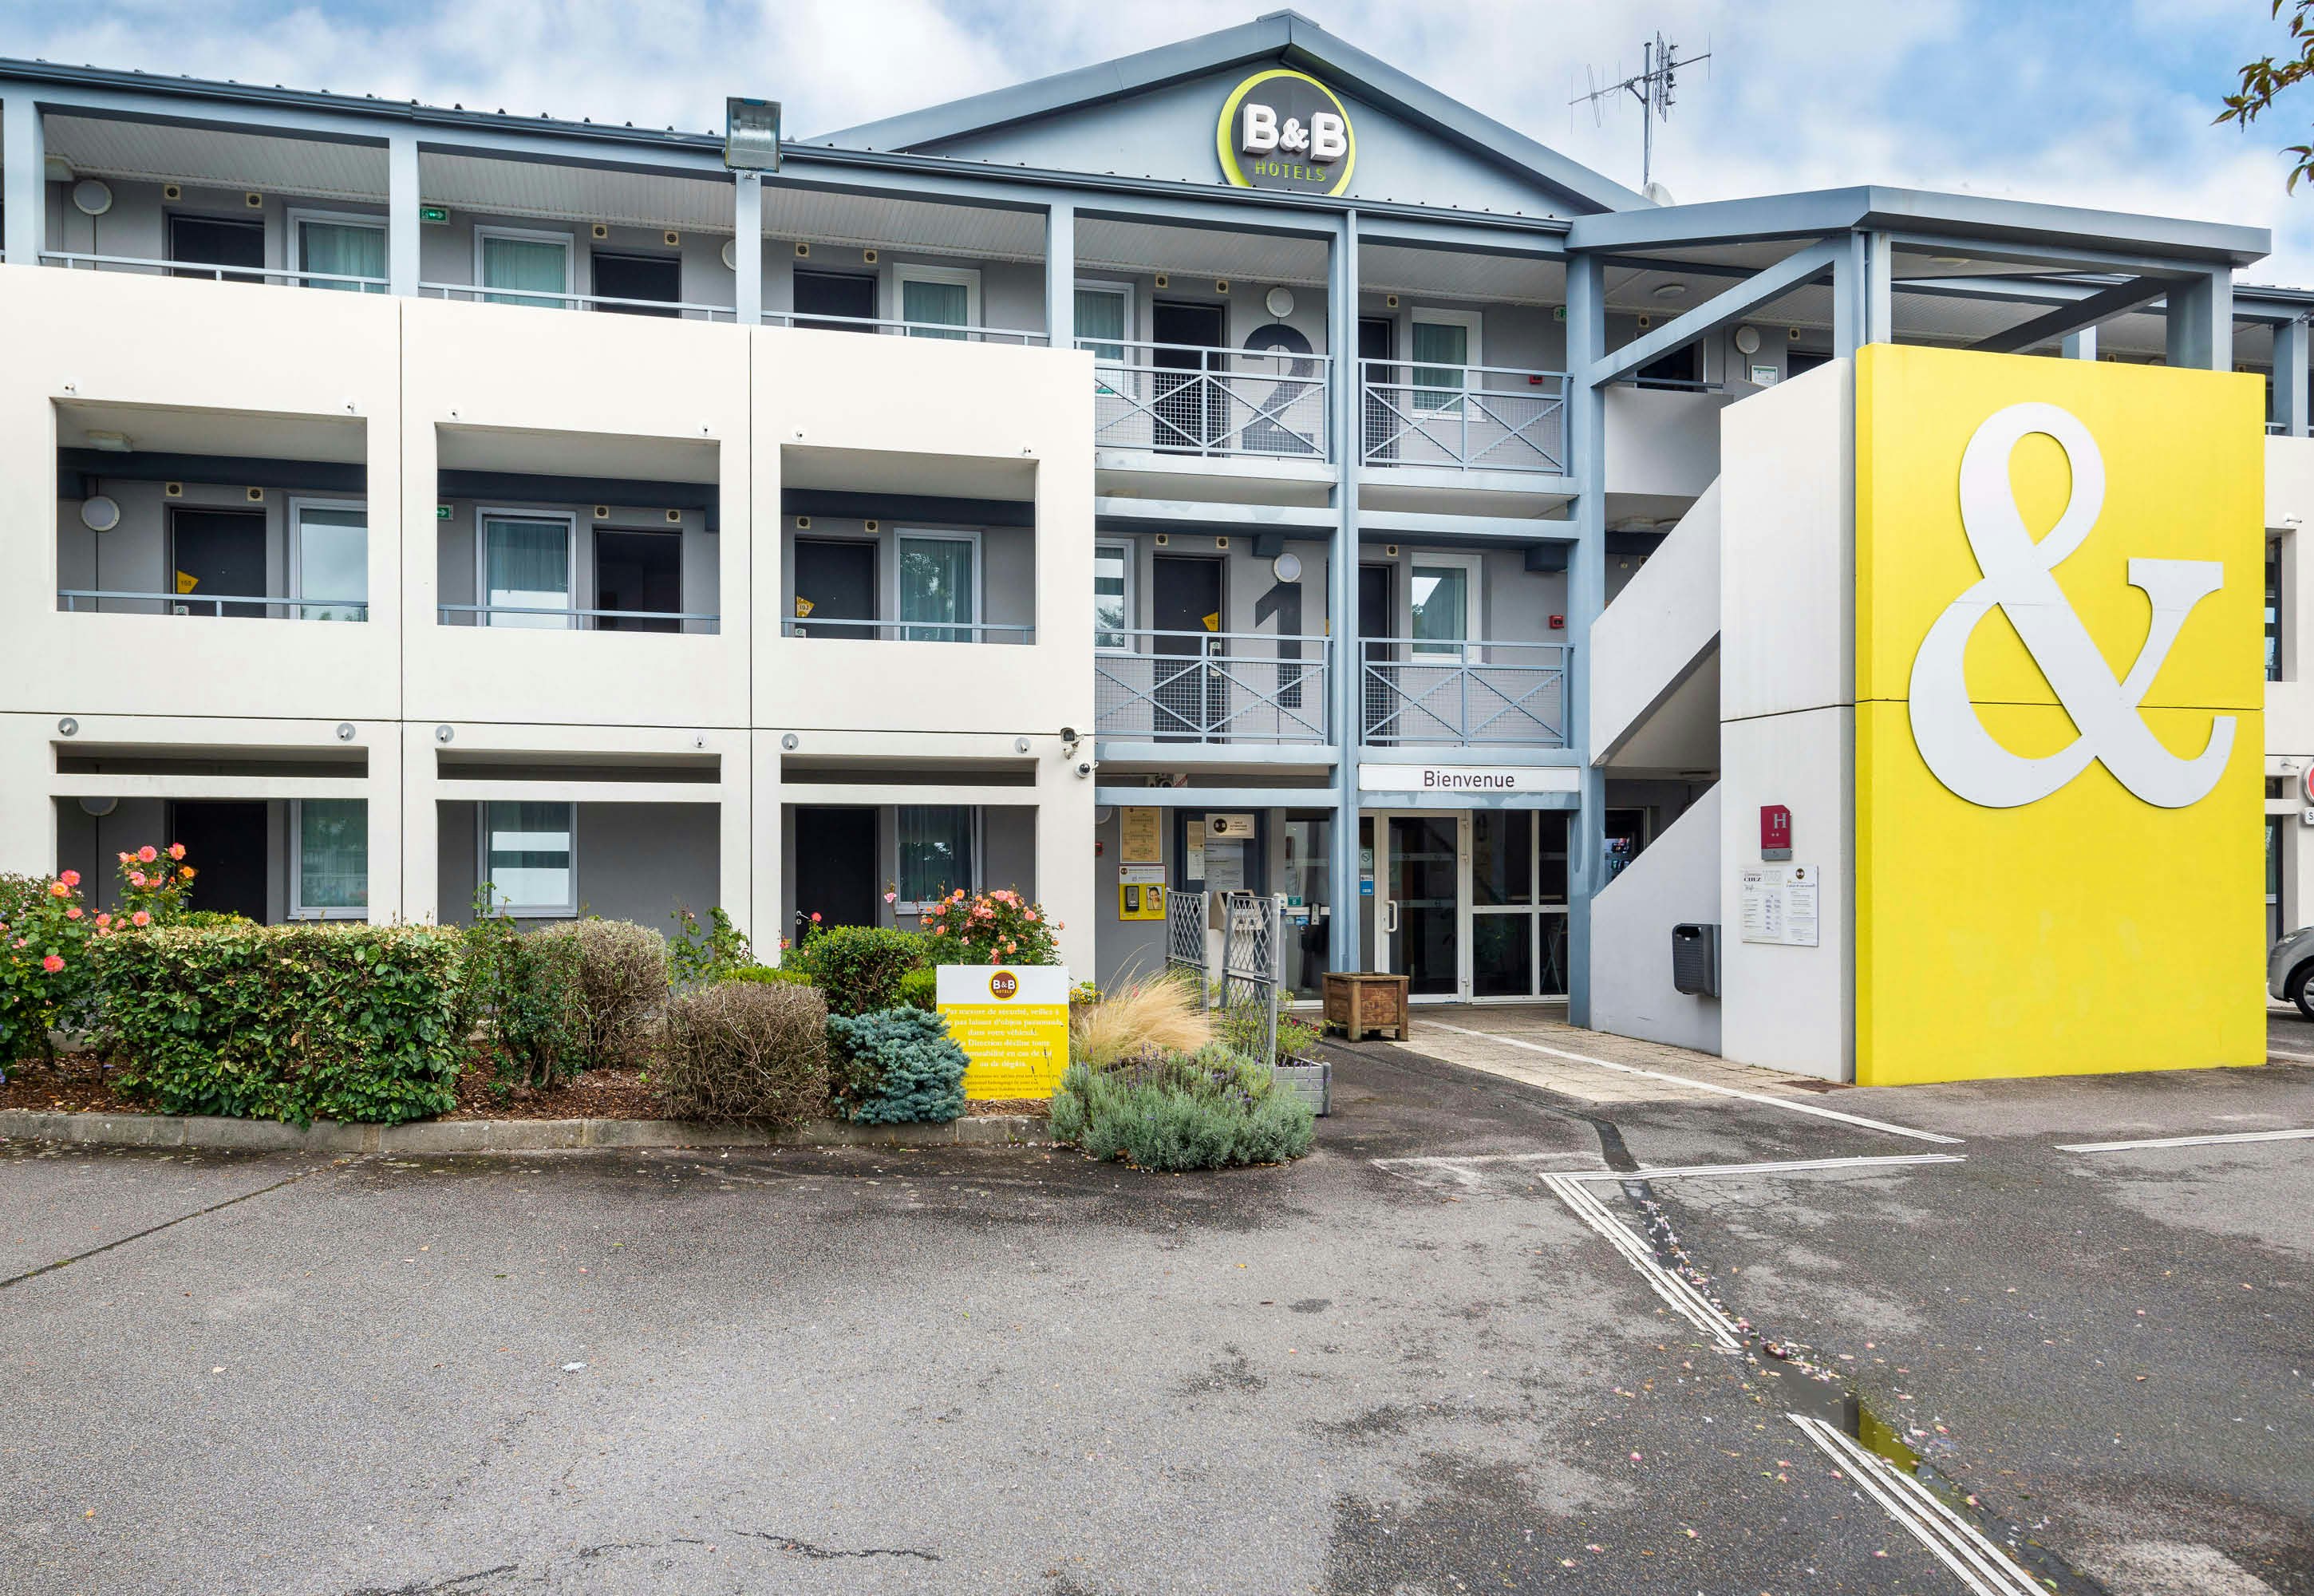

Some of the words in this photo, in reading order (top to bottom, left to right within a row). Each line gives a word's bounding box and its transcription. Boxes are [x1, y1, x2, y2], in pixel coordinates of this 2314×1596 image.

[1242, 103, 1347, 162] B&B
[1255, 160, 1326, 182] HOTELS
[1241, 323, 1315, 454] 2
[1909, 401, 2237, 809] &
[1255, 583, 1303, 709] 1
[1424, 770, 1514, 788] Bienvenue
[1774, 812, 1787, 829] H
[993, 979, 1016, 990] B&B
